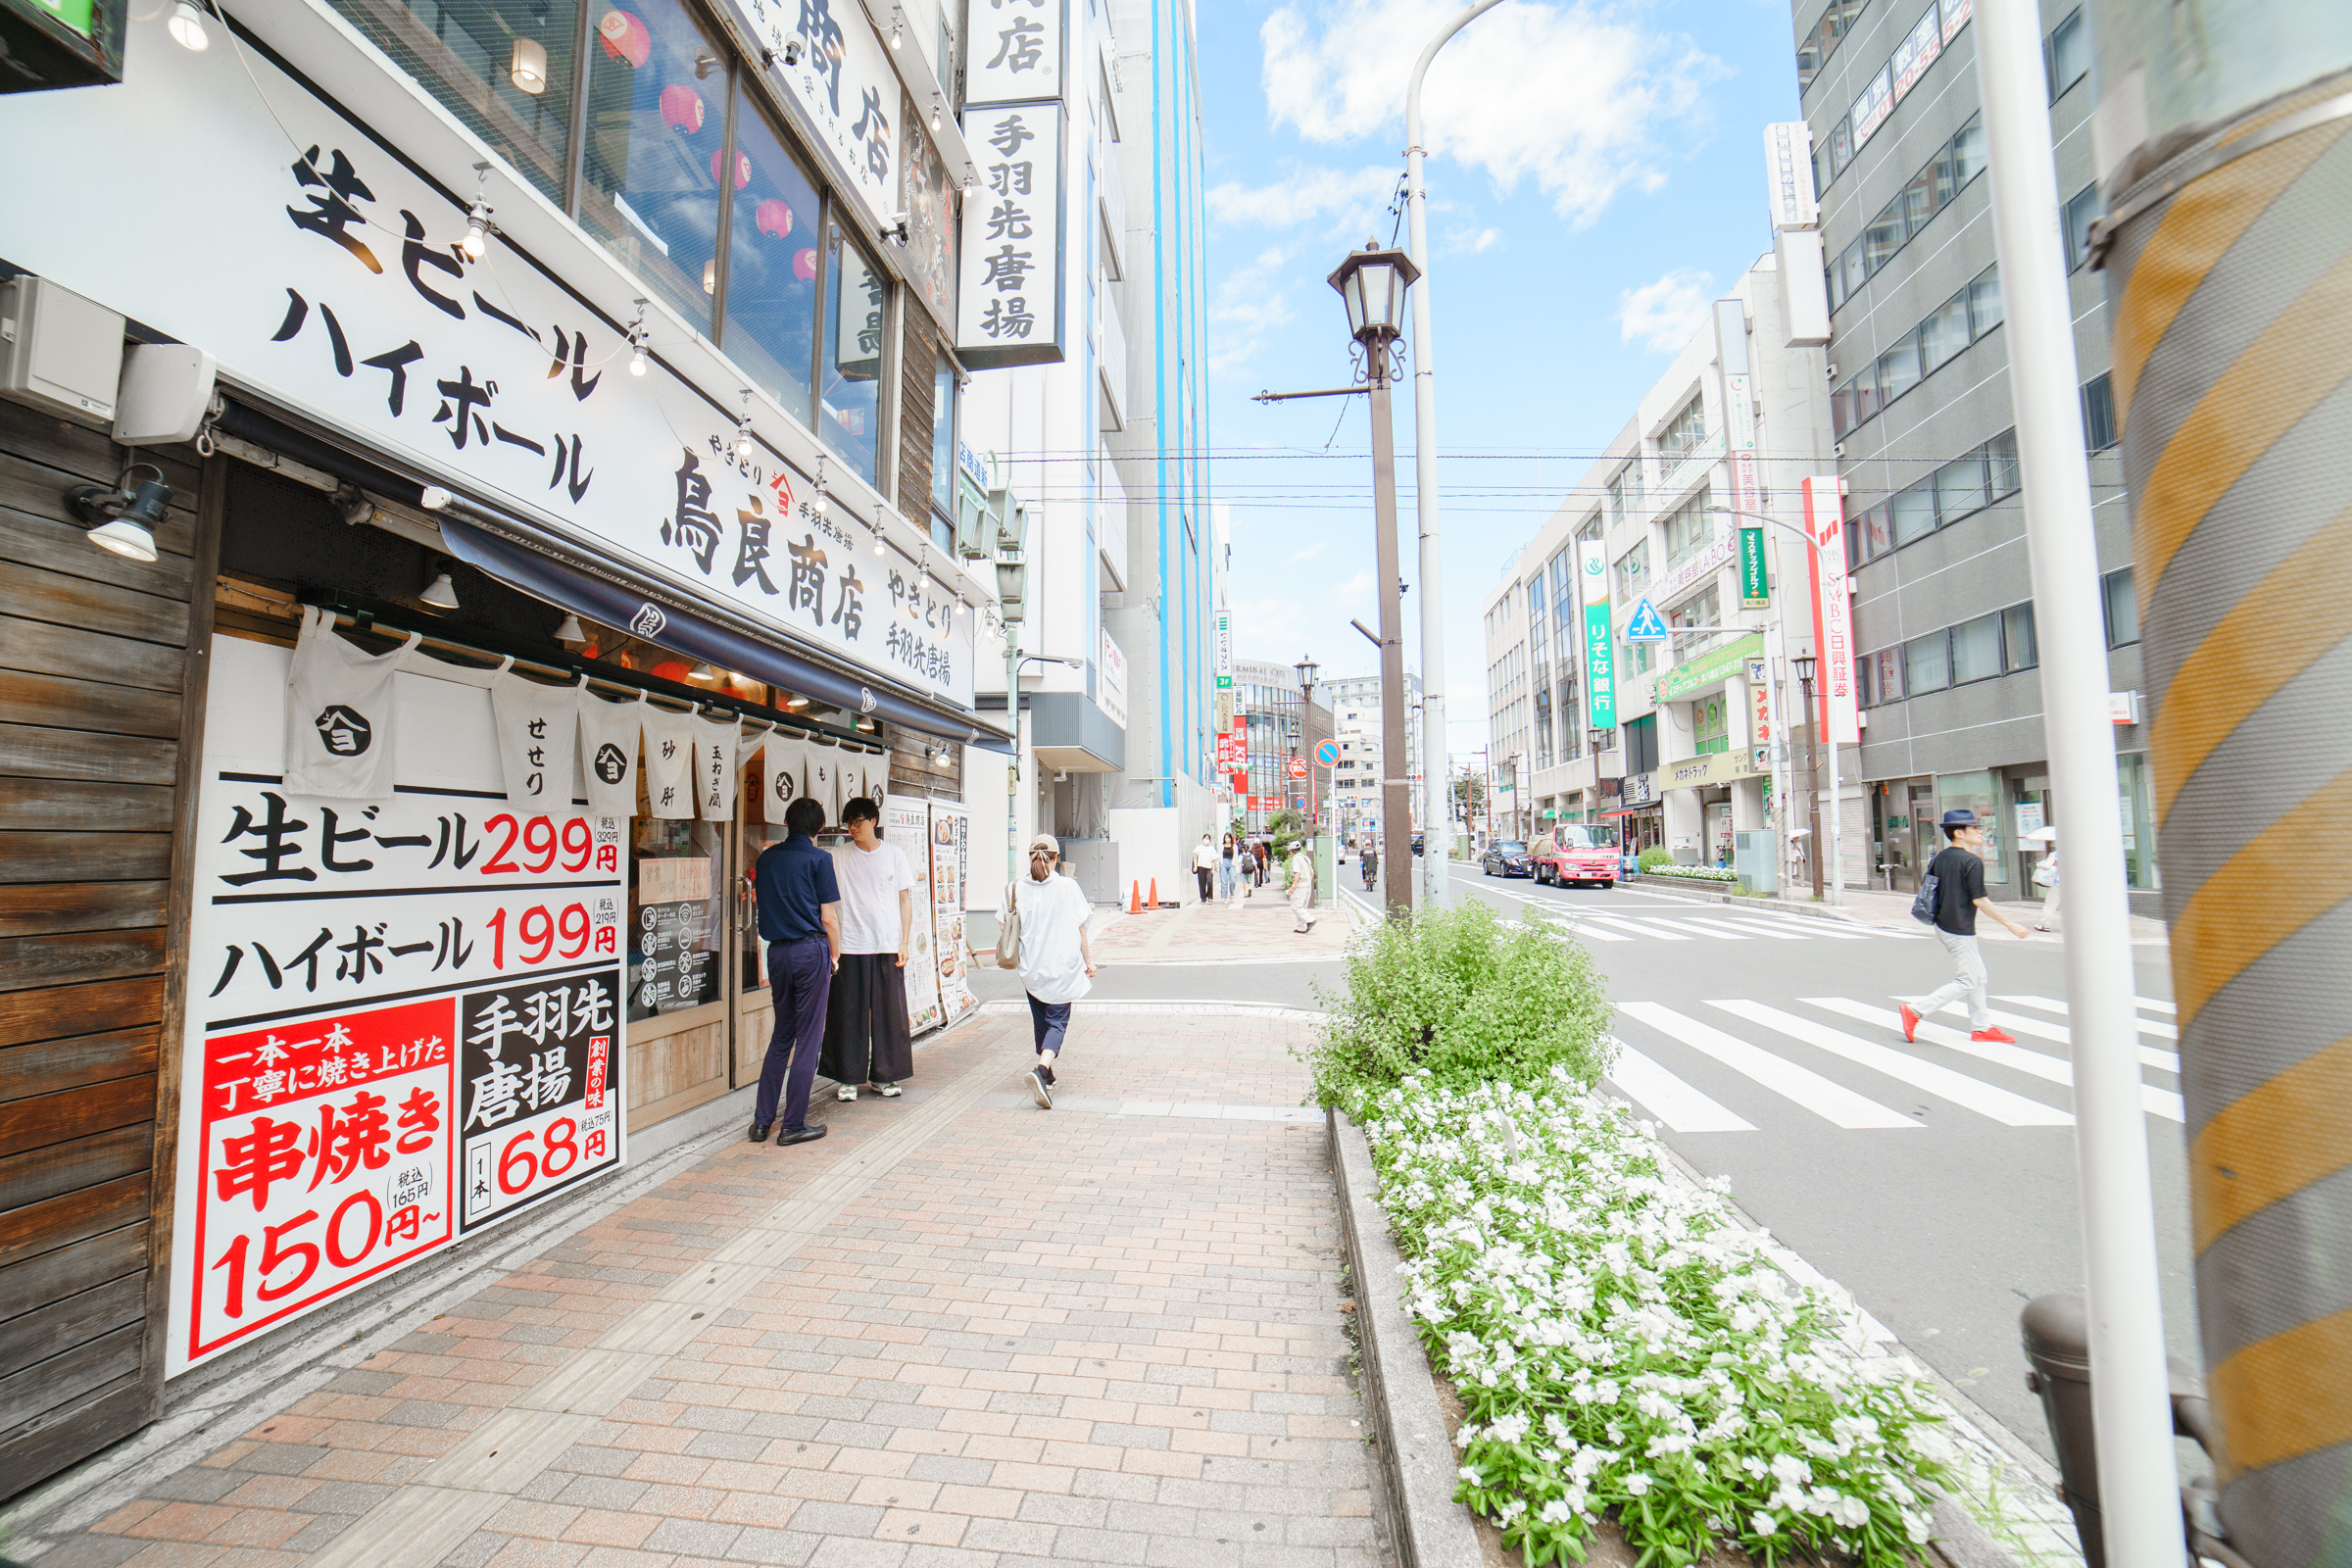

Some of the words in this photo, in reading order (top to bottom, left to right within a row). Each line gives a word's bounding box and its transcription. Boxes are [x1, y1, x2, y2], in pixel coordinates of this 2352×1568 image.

[985, 0, 1046, 74] 店
[981, 114, 1036, 339] 手羽先唐揚
[286, 144, 603, 402] 生ビール
[271, 287, 595, 505] ハイボール
[708, 433, 762, 486] やきとり
[1742, 474, 1756, 511] 美容室
[660, 448, 864, 642] 鳥良商店
[798, 502, 855, 552] 手羽先唐揚
[1747, 541, 1760, 590] ステップゴルフ
[886, 568, 952, 639] やきとり
[885, 620, 951, 687] 手羽先唐揚
[1233, 664, 1267, 674] ERMINAL
[1591, 623, 1613, 711] りそな銀行
[525, 716, 548, 796] せせり
[660, 740, 676, 808] 砂肝
[1674, 763, 1709, 782] メガネドラッグ
[218, 791, 480, 888] 生ビール
[480, 813, 617, 875] 299円
[209, 916, 474, 998] ハイボール
[485, 902, 616, 970] 199円
[216, 1023, 354, 1068] 一本一本
[466, 980, 614, 1060] 手羽先
[216, 1035, 447, 1111] 丁寧に焼き上げた
[463, 1046, 572, 1132] 唐揚
[586, 1040, 607, 1107] 創業の味
[213, 1086, 441, 1212] 串焼き
[397, 1168, 423, 1187] 税込
[497, 1117, 607, 1196] 68円
[392, 1182, 429, 1209] 165円
